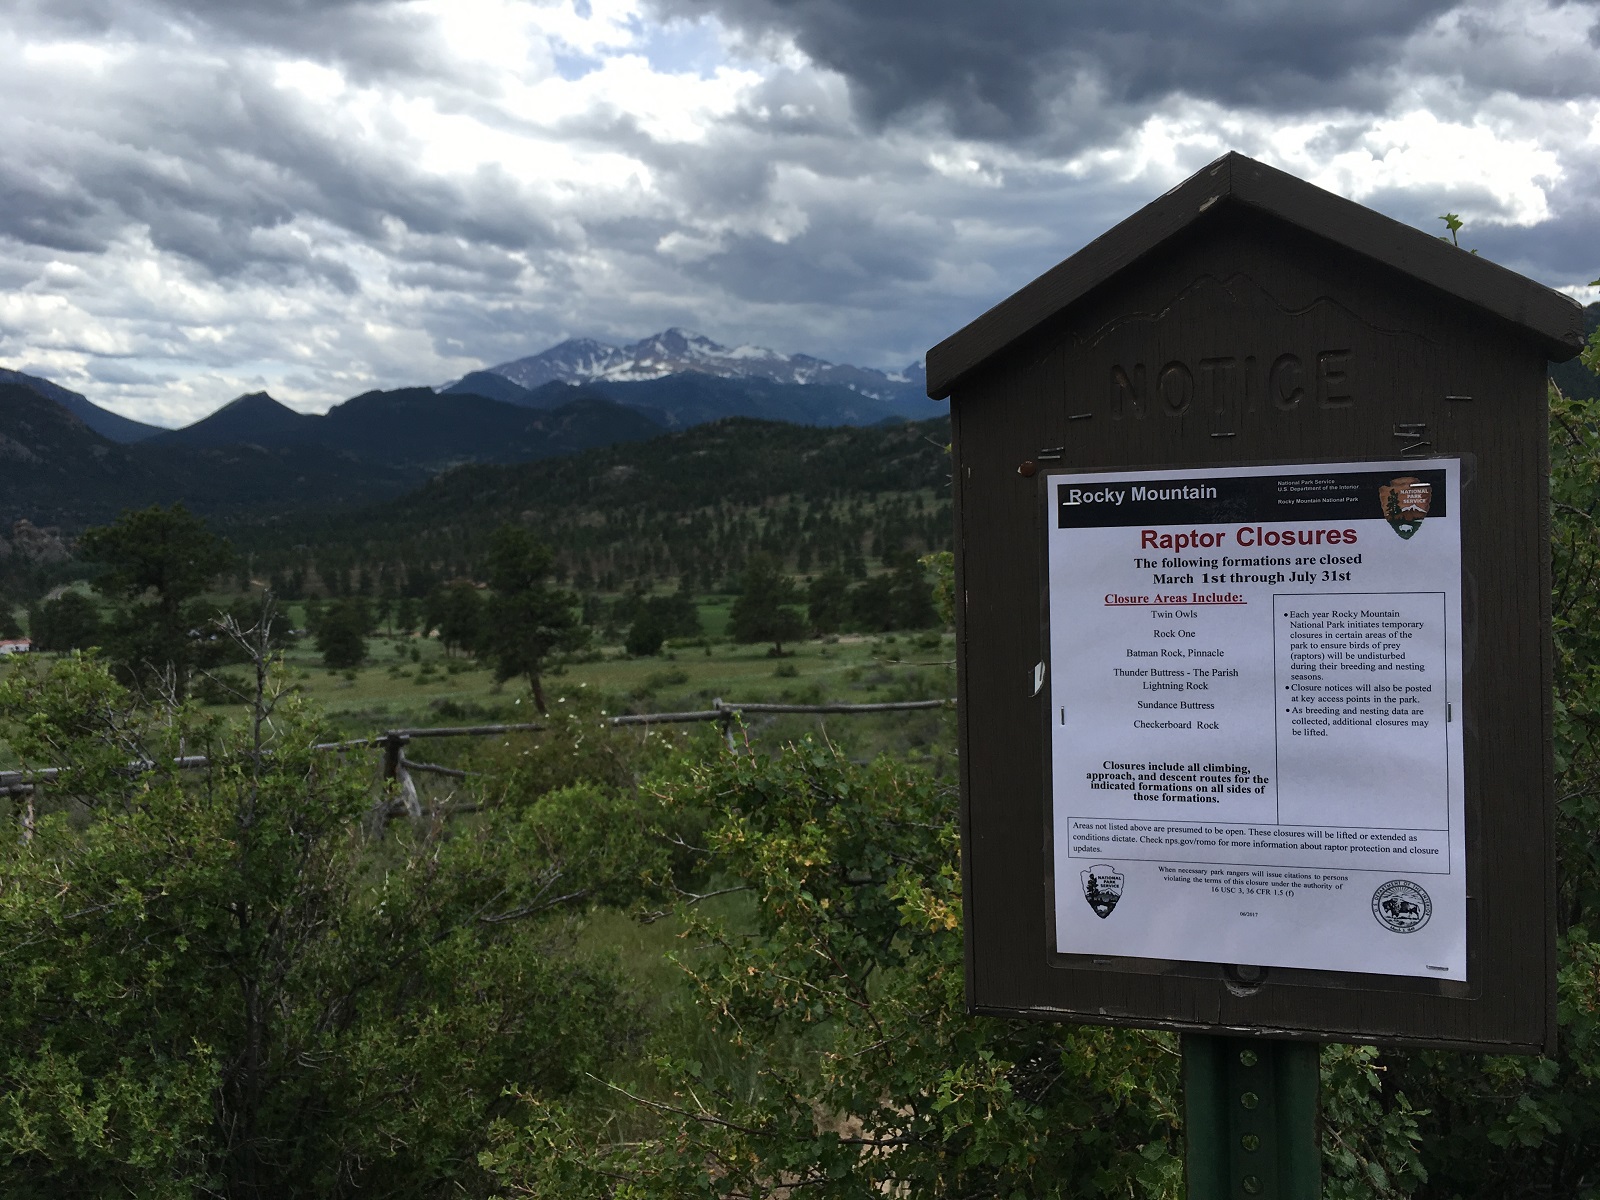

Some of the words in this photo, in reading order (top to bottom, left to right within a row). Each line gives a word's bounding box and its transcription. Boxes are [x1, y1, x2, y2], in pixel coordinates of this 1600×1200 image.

[1110, 348, 1355, 420] NOTICE
[1069, 488, 1125, 505] Rocky
[1130, 485, 1217, 502] Mountain
[1141, 529, 1226, 553] Raptor
[1236, 527, 1357, 547] Closures
[1134, 558, 1158, 568] The
[1162, 557, 1218, 570] following
[1222, 555, 1291, 566] formations
[1295, 557, 1316, 565] are
[1319, 554, 1362, 565] closed
[1153, 573, 1194, 584] March
[1202, 573, 1226, 583] 1st
[1230, 572, 1285, 585] through
[1288, 571, 1317, 584] July
[1322, 570, 1351, 582] 31st
[1104, 593, 1149, 604] Closure
[1154, 593, 1188, 603] Areas
[1192, 592, 1244, 603] Include:
[1151, 610, 1173, 618] Twin
[1175, 610, 1198, 618] Owls
[1290, 610, 1309, 618] Each
[1312, 612, 1330, 620] year
[1332, 610, 1358, 620] Rocky
[1360, 610, 1400, 618] Mountain
[1326, 620, 1345, 628] Park
[1348, 620, 1380, 628] initiates
[1382, 622, 1424, 630] temporary
[1154, 630, 1176, 638] Rock
[1178, 630, 1196, 638] One
[1290, 631, 1323, 639] closures
[1290, 642, 1308, 651] park
[1349, 641, 1370, 649] birds
[1372, 641, 1382, 649] of
[1383, 643, 1401, 651] prey
[1126, 649, 1158, 657] Batman
[1161, 649, 1185, 658] Rock,
[1188, 648, 1224, 657] Pinnacle
[1290, 652, 1325, 662] (raptors)
[1327, 652, 1343, 660] will
[1345, 652, 1355, 660] be
[1357, 652, 1406, 660] undisturbed
[1290, 662, 1317, 672] during
[1319, 662, 1338, 670] their
[1340, 662, 1376, 672] breeding
[1378, 662, 1393, 670] and
[1396, 664, 1425, 672] nesting
[1113, 668, 1148, 676] Thunder
[1150, 668, 1184, 676] Buttress
[1192, 668, 1210, 677] The
[1212, 668, 1238, 677] Parish
[1143, 681, 1184, 692] Lightning
[1186, 682, 1208, 690] Rock
[1324, 684, 1353, 692] notices
[1356, 684, 1371, 692] will
[1374, 684, 1391, 692] also
[1392, 684, 1402, 692] be
[1405, 684, 1432, 694] posted
[1301, 694, 1315, 704] key
[1346, 695, 1371, 704] points
[1384, 695, 1396, 703] the
[1399, 696, 1420, 705] park.
[1138, 700, 1178, 709] Sundance
[1180, 701, 1215, 710] Buttress
[1305, 706, 1340, 716] breeding
[1360, 707, 1390, 716] nesting
[1392, 707, 1409, 715] data
[1134, 720, 1192, 729] Checkerboard
[1197, 721, 1219, 730] Rock
[1292, 717, 1330, 726] collected,
[1332, 718, 1372, 726] additional
[1375, 718, 1408, 726] closures
[1292, 728, 1302, 736] be
[1304, 728, 1328, 736] lifted.
[1103, 761, 1146, 770] Closures
[1148, 762, 1185, 772] include
[1188, 763, 1200, 772] all
[1203, 763, 1250, 775] climbing,
[1086, 771, 1136, 782] approach,
[1138, 772, 1156, 781] and
[1160, 772, 1196, 782] descent
[1200, 774, 1231, 783] routes
[1234, 774, 1250, 783] for
[1253, 775, 1269, 784] the
[1091, 781, 1135, 790] indicated
[1138, 782, 1192, 792] formations
[1211, 784, 1224, 793] all
[1226, 784, 1251, 794] sides
[1254, 785, 1266, 794] of
[1133, 792, 1159, 801] those
[1162, 792, 1220, 803] formations.
[1109, 823, 1128, 831] listed
[1130, 824, 1152, 832] above
[1167, 826, 1203, 834] presumed
[1248, 828, 1271, 836] These
[1273, 829, 1305, 838] closures
[1307, 830, 1322, 838] will
[1336, 831, 1357, 840] lifted
[1370, 833, 1406, 841] extended
[1072, 833, 1110, 842] conditions
[1111, 834, 1138, 842] dictate.
[1140, 836, 1163, 844] Check
[1165, 838, 1216, 846] nps.gov/romo
[1218, 838, 1229, 846] for
[1253, 840, 1298, 849] information
[1300, 842, 1322, 850] about
[1324, 844, 1348, 852] raptor
[1350, 844, 1390, 853] protection
[1392, 846, 1408, 854] and
[1409, 846, 1439, 854] closure
[1073, 845, 1102, 853] updates.
